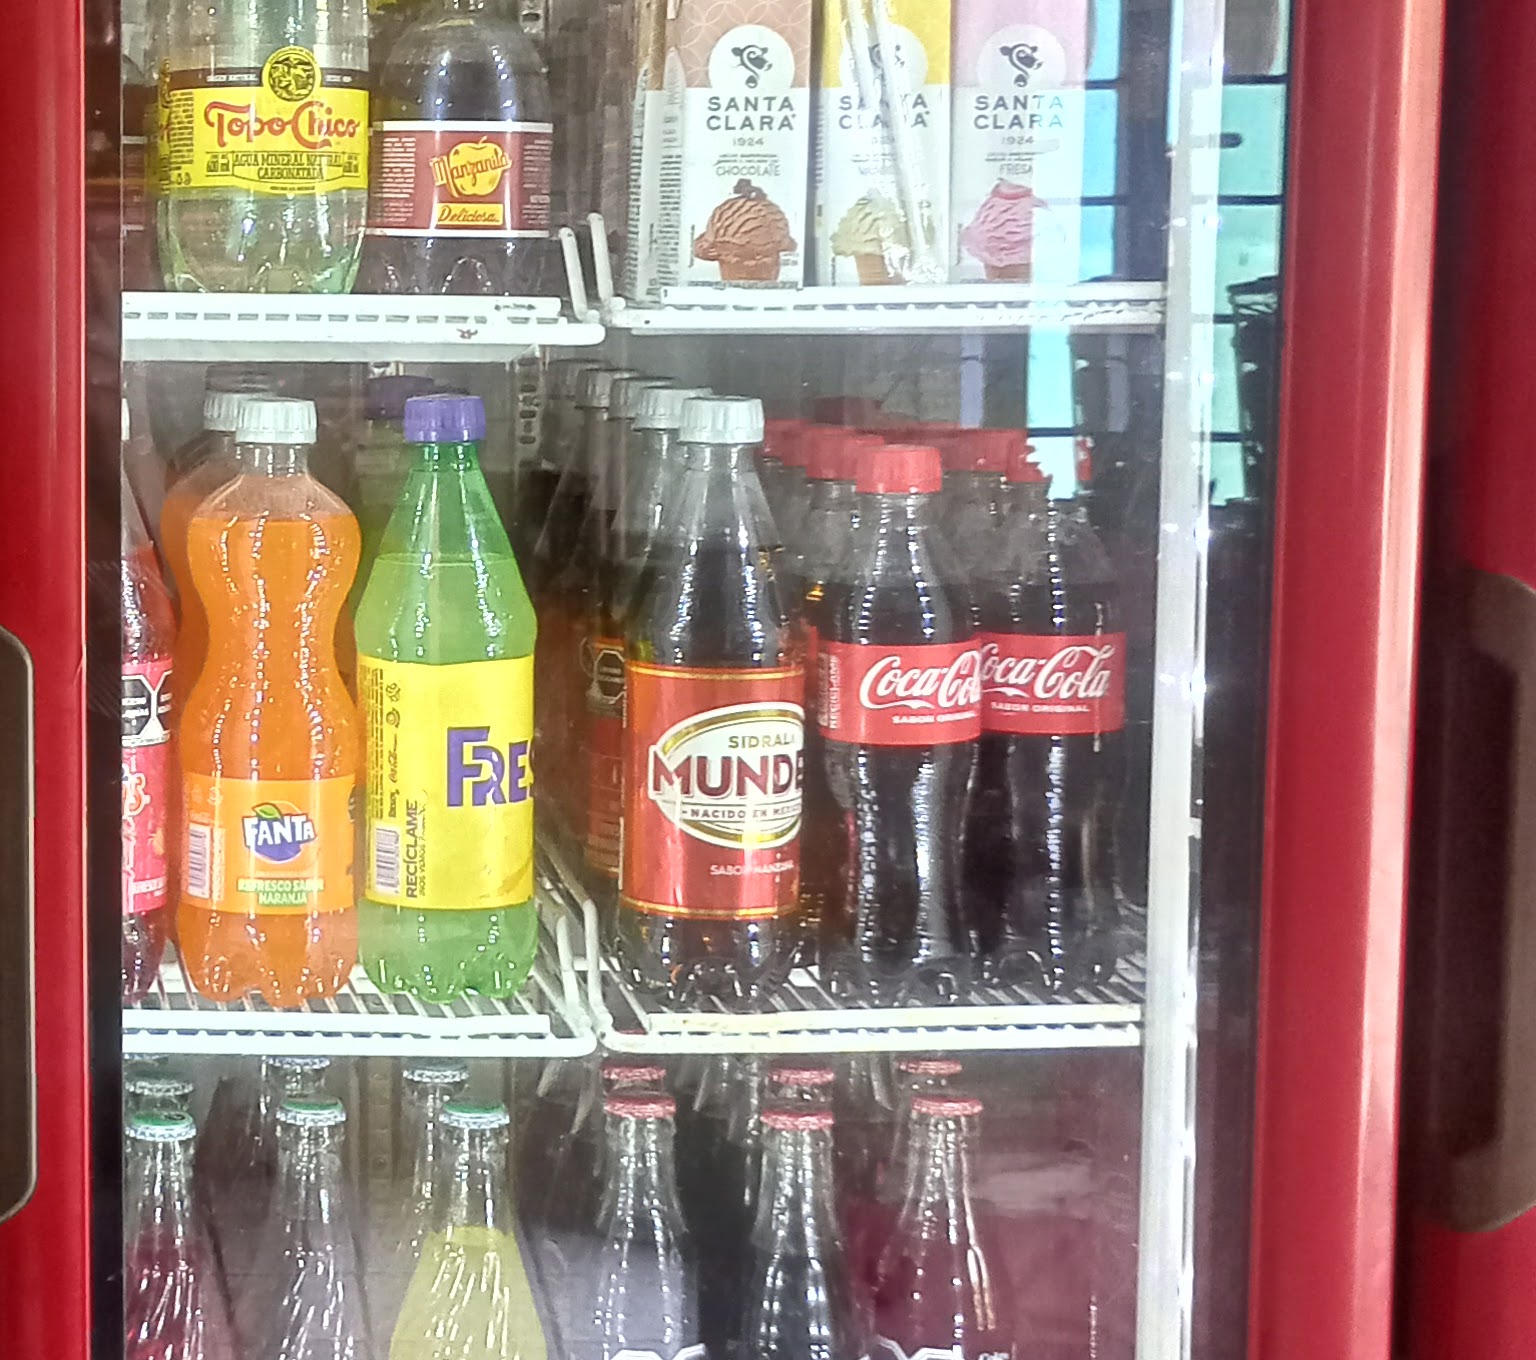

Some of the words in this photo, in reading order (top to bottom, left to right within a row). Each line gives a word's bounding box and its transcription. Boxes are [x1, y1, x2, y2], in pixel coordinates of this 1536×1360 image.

[707, 96, 795, 113] SANTA
[839, 95, 928, 112] SAA
[974, 95, 1064, 112] SANTA
[204, 101, 290, 148] Topo
[290, 100, 361, 150] Chico
[706, 114, 796, 131] CLARA
[839, 114, 928, 129] CLAA
[974, 113, 1064, 130] CLARA
[732, 137, 765, 147] 1924
[1000, 136, 1035, 146] 1924
[233, 154, 260, 167] AGUA
[261, 154, 304, 167] MINERAL
[715, 161, 782, 177] CHOCOLATE
[429, 151, 512, 197] Manzanita
[438, 205, 500, 223] Deliciosa
[990, 701, 1030, 713] SABOR
[1032, 702, 1091, 713] ORIGINAL
[891, 713, 935, 724] SABOR
[728, 732, 790, 749] SIDRAL
[446, 725, 534, 808] FRE
[690, 808, 746, 820] NACIDO
[243, 813, 315, 846] FANTA
[258, 892, 308, 905] NARANJA
